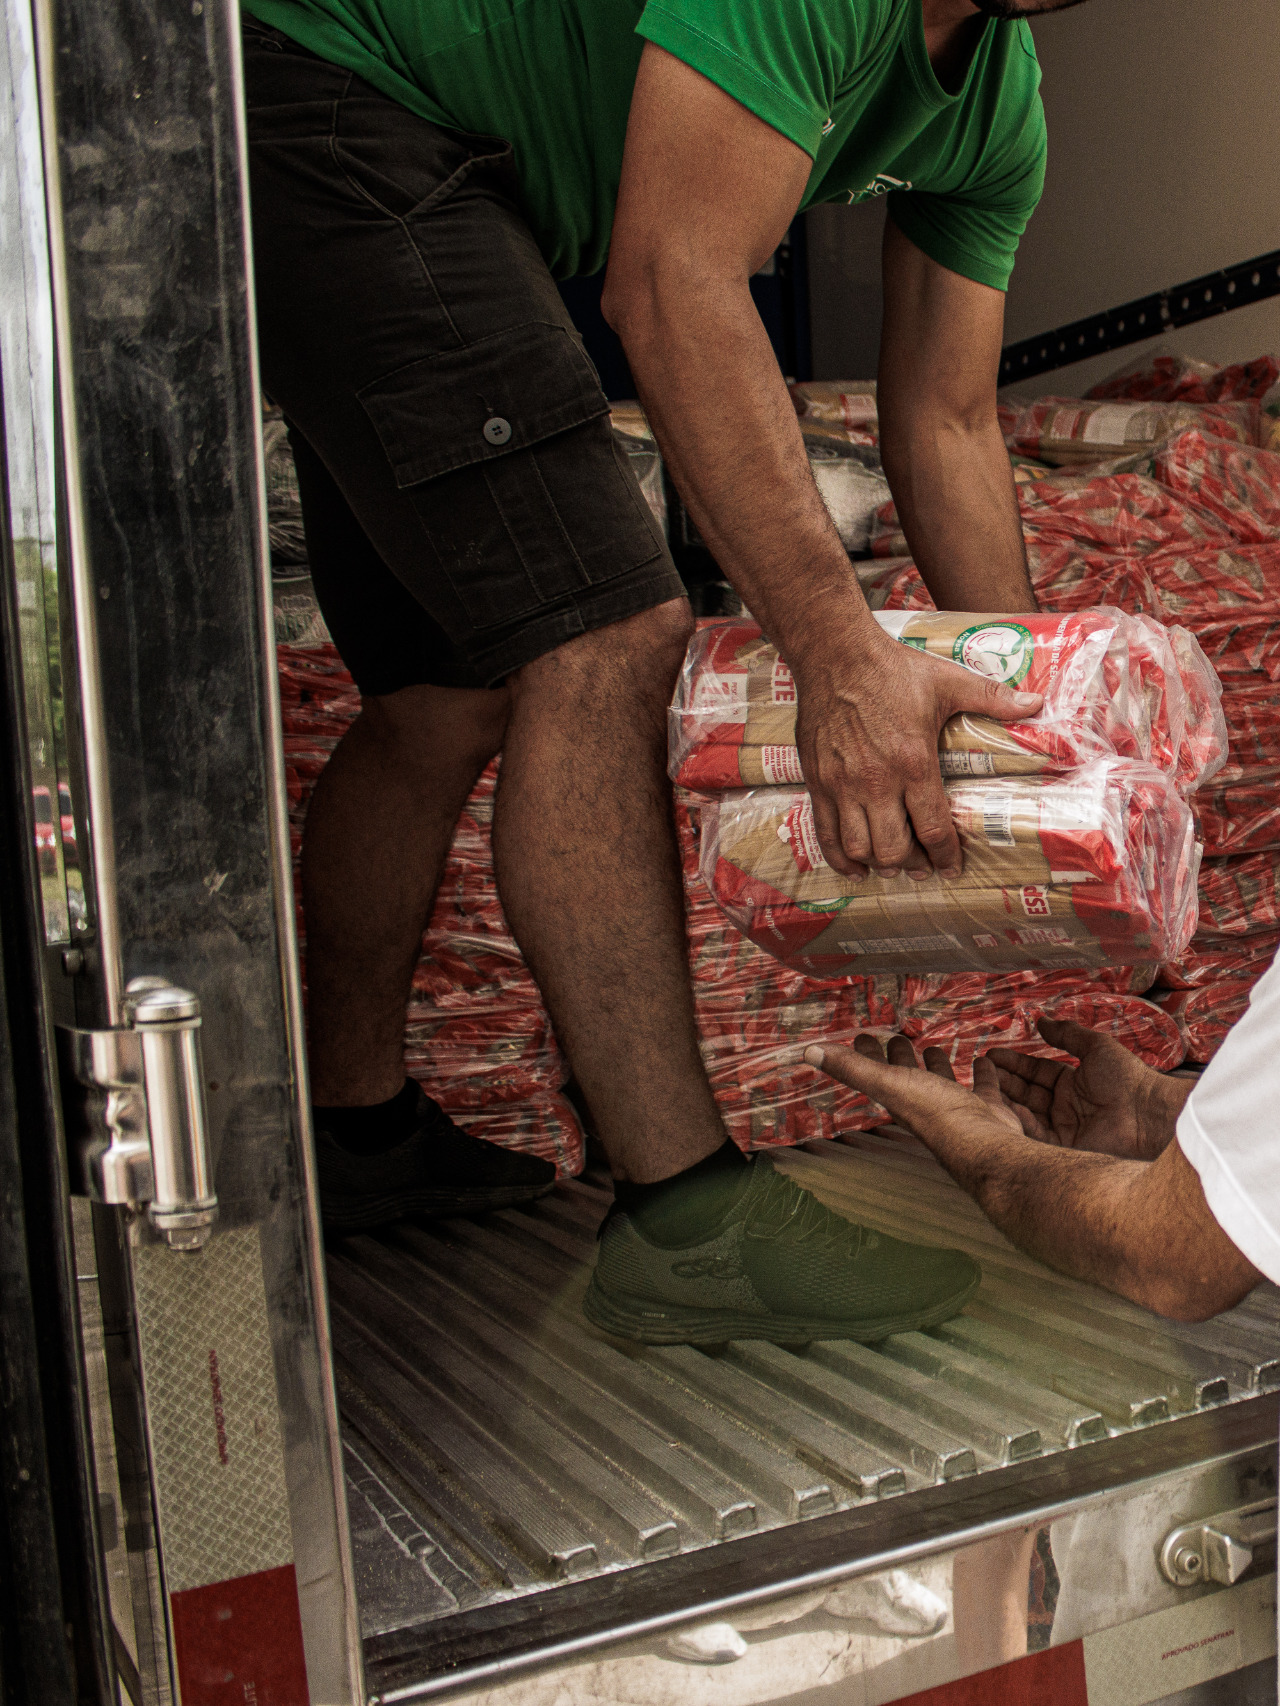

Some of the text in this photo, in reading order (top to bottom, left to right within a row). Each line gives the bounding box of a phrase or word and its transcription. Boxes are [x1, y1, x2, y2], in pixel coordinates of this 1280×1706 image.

[954, 631, 971, 652] Nossa
[794, 830, 801, 839] de
[795, 839, 805, 857] Modo
[1161, 1628, 1235, 1660] APROVADO SENATRAN
